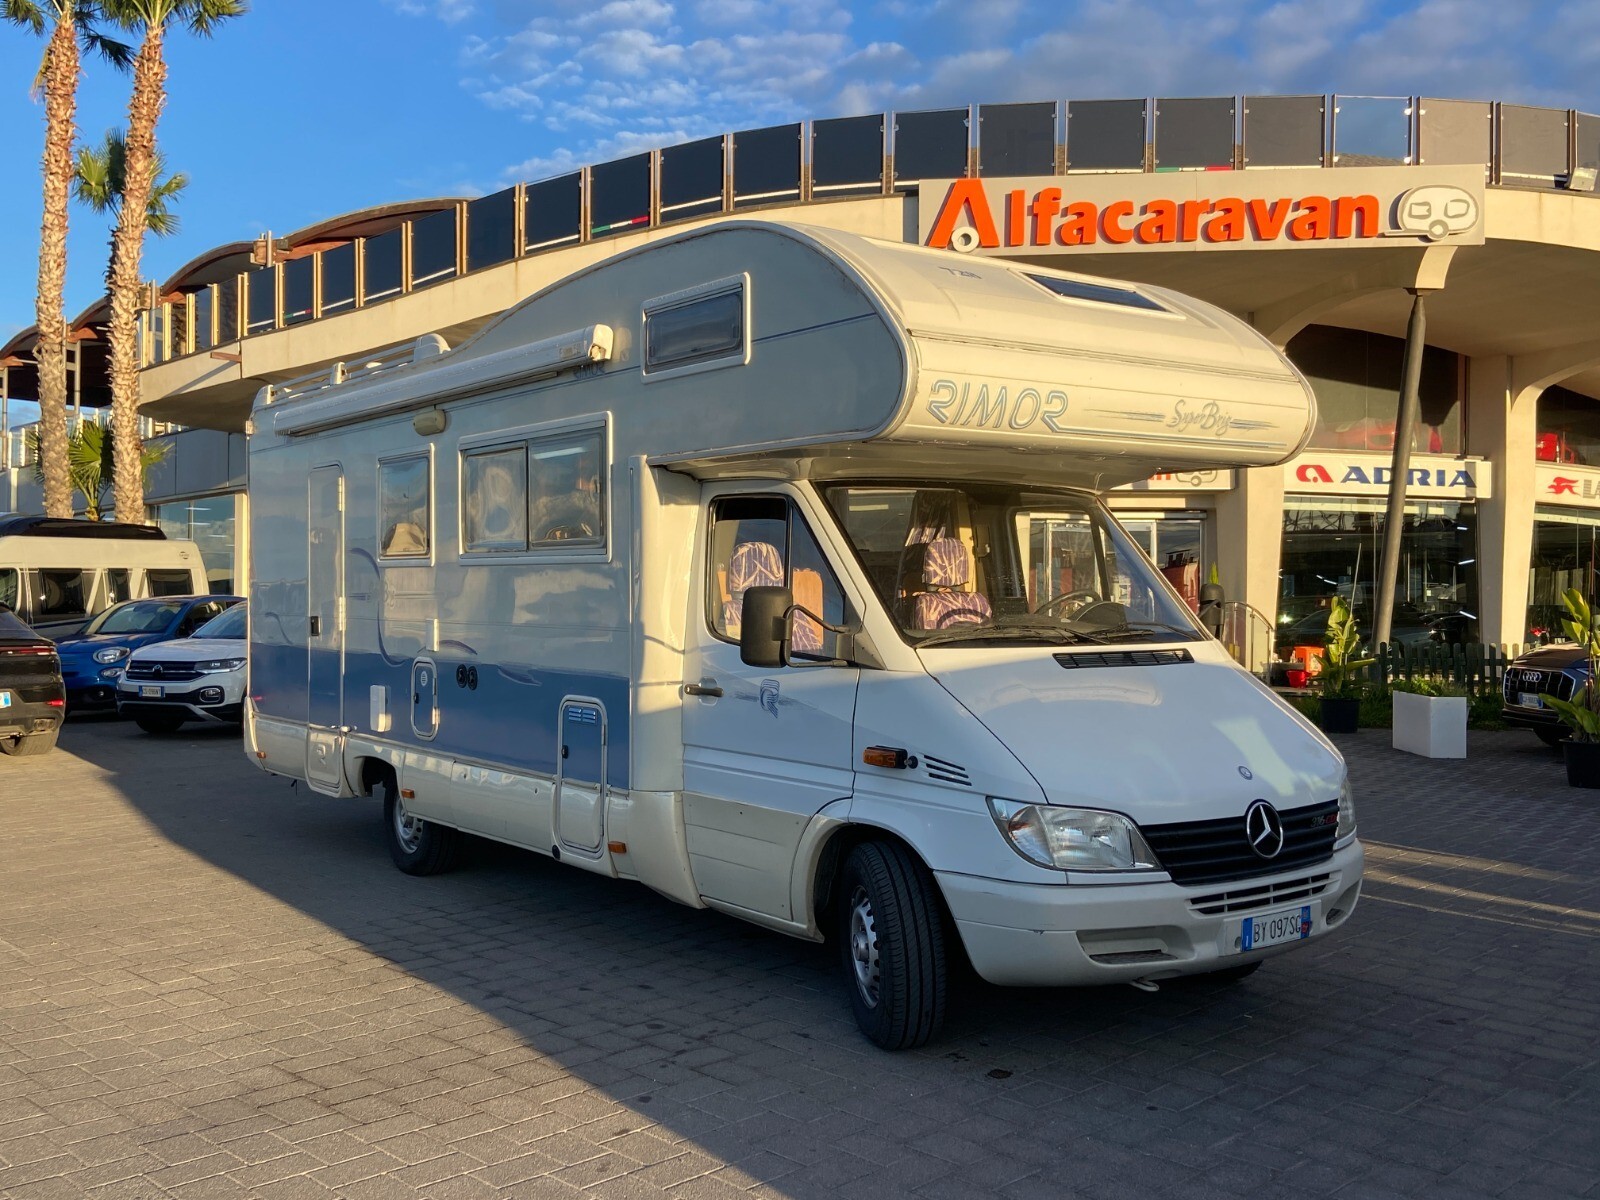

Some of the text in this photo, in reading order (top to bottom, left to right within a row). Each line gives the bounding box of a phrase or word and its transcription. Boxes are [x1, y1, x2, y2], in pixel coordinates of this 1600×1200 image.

[928, 178, 1380, 249] Alfacaravan
[926, 380, 1068, 432] RIMOR
[1340, 466, 1477, 488] ADRIA
[1253, 921, 1267, 943] BY
